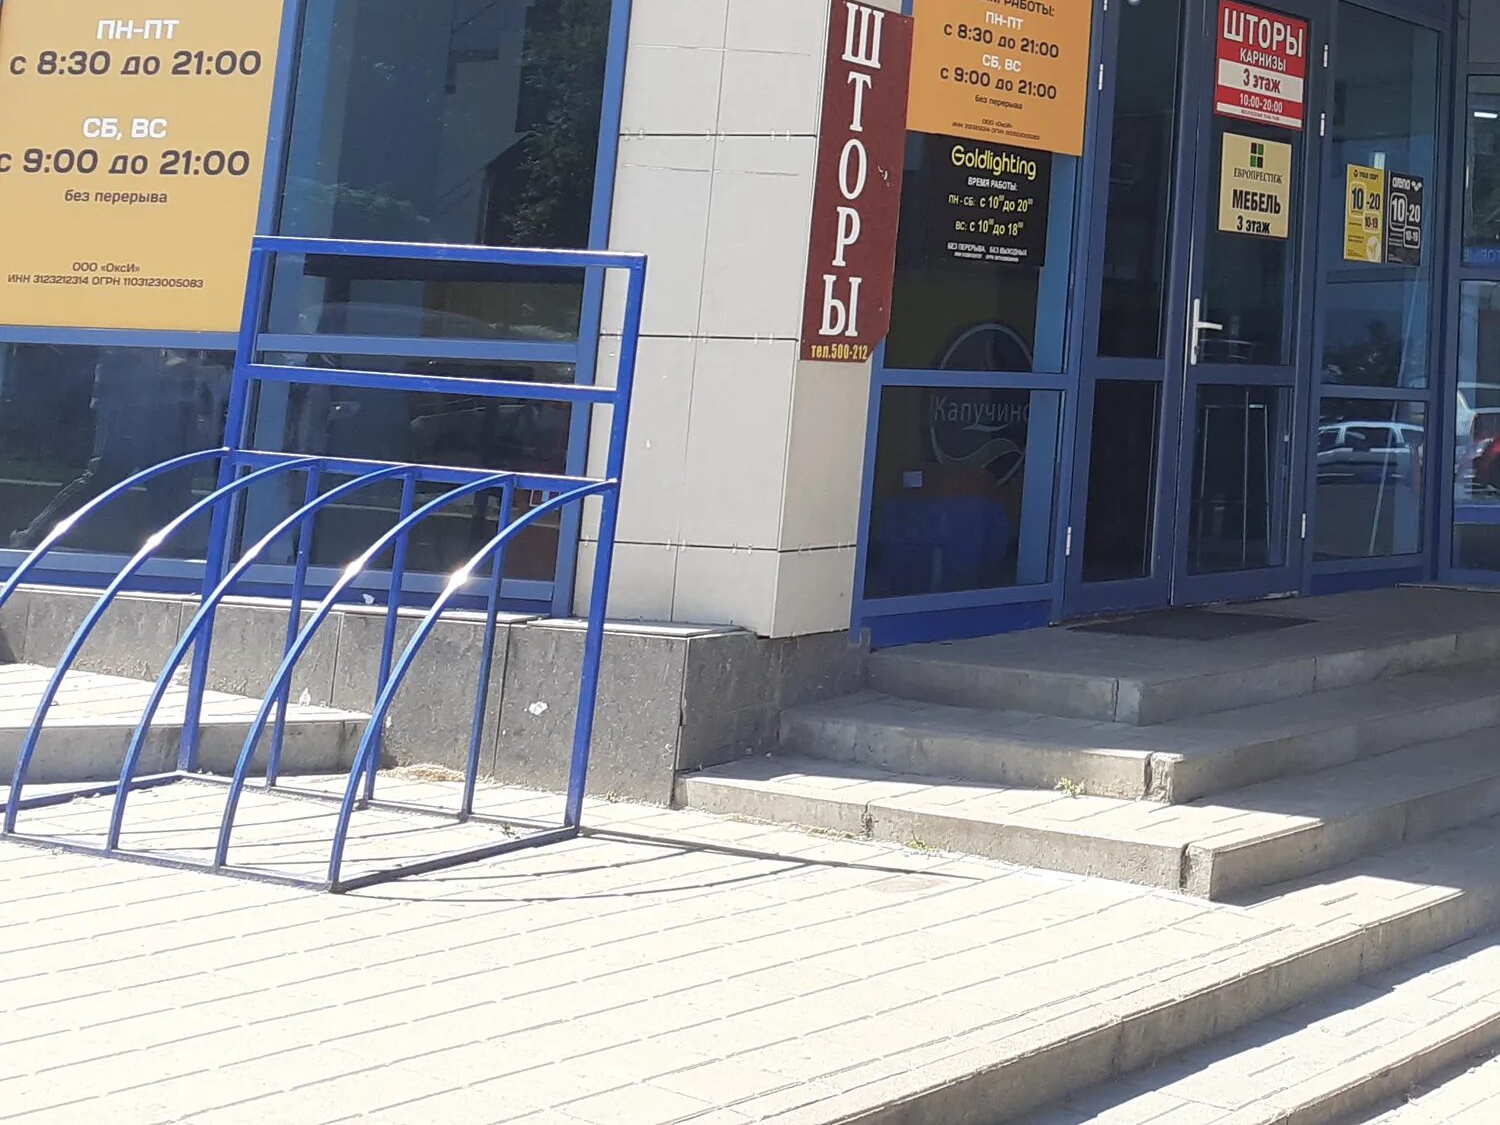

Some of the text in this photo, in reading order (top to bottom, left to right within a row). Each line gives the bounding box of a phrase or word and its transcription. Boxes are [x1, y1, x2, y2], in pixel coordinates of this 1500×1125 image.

[96, 19, 180, 40] ПН-ПТ
[985, 11, 1024, 30] ПН-ПТ
[957, 24, 993, 44] 8:30
[997, 36, 1016, 49] до
[1020, 38, 1059, 58] 21:00
[1223, 7, 1303, 57] ШТОРЫ
[37, 50, 111, 75] 8:30
[121, 56, 161, 75] до
[171, 50, 262, 75] 21:00
[982, 54, 1022, 72] СБ, ВС
[1240, 47, 1286, 72] КАРНИЗЫ
[953, 67, 991, 87] 9:00
[994, 78, 1013, 92] до
[1018, 79, 1057, 100] 21:00
[1243, 68, 1281, 93] 3 этаж
[975, 94, 988, 104] без
[1240, 93, 1283, 113] 10:00-20:00
[83, 118, 168, 140] СБ, ВС
[23, 148, 98, 174] 9:00
[109, 154, 149, 175] до
[159, 149, 250, 176] 21:00
[819, 2, 885, 337] ШТОРЫ
[951, 145, 1036, 180] Goldlighting
[968, 177, 1018, 191] ВРЕМЯ РАБОТЫ:
[1234, 168, 1283, 184] ЕВРОПРЕСТИЖ
[1392, 177, 1410, 190] arena
[64, 189, 168, 205] без перерыва
[1002, 200, 1015, 212] до
[1232, 189, 1281, 214] МЕБЕЛЬ
[993, 224, 1005, 236] до
[1237, 215, 1270, 234] 3 этаж
[72, 261, 98, 273] ООО
[7, 274, 31, 284] ИНН
[91, 276, 121, 286] ОГРН
[811, 343, 868, 361] тел.500-212
